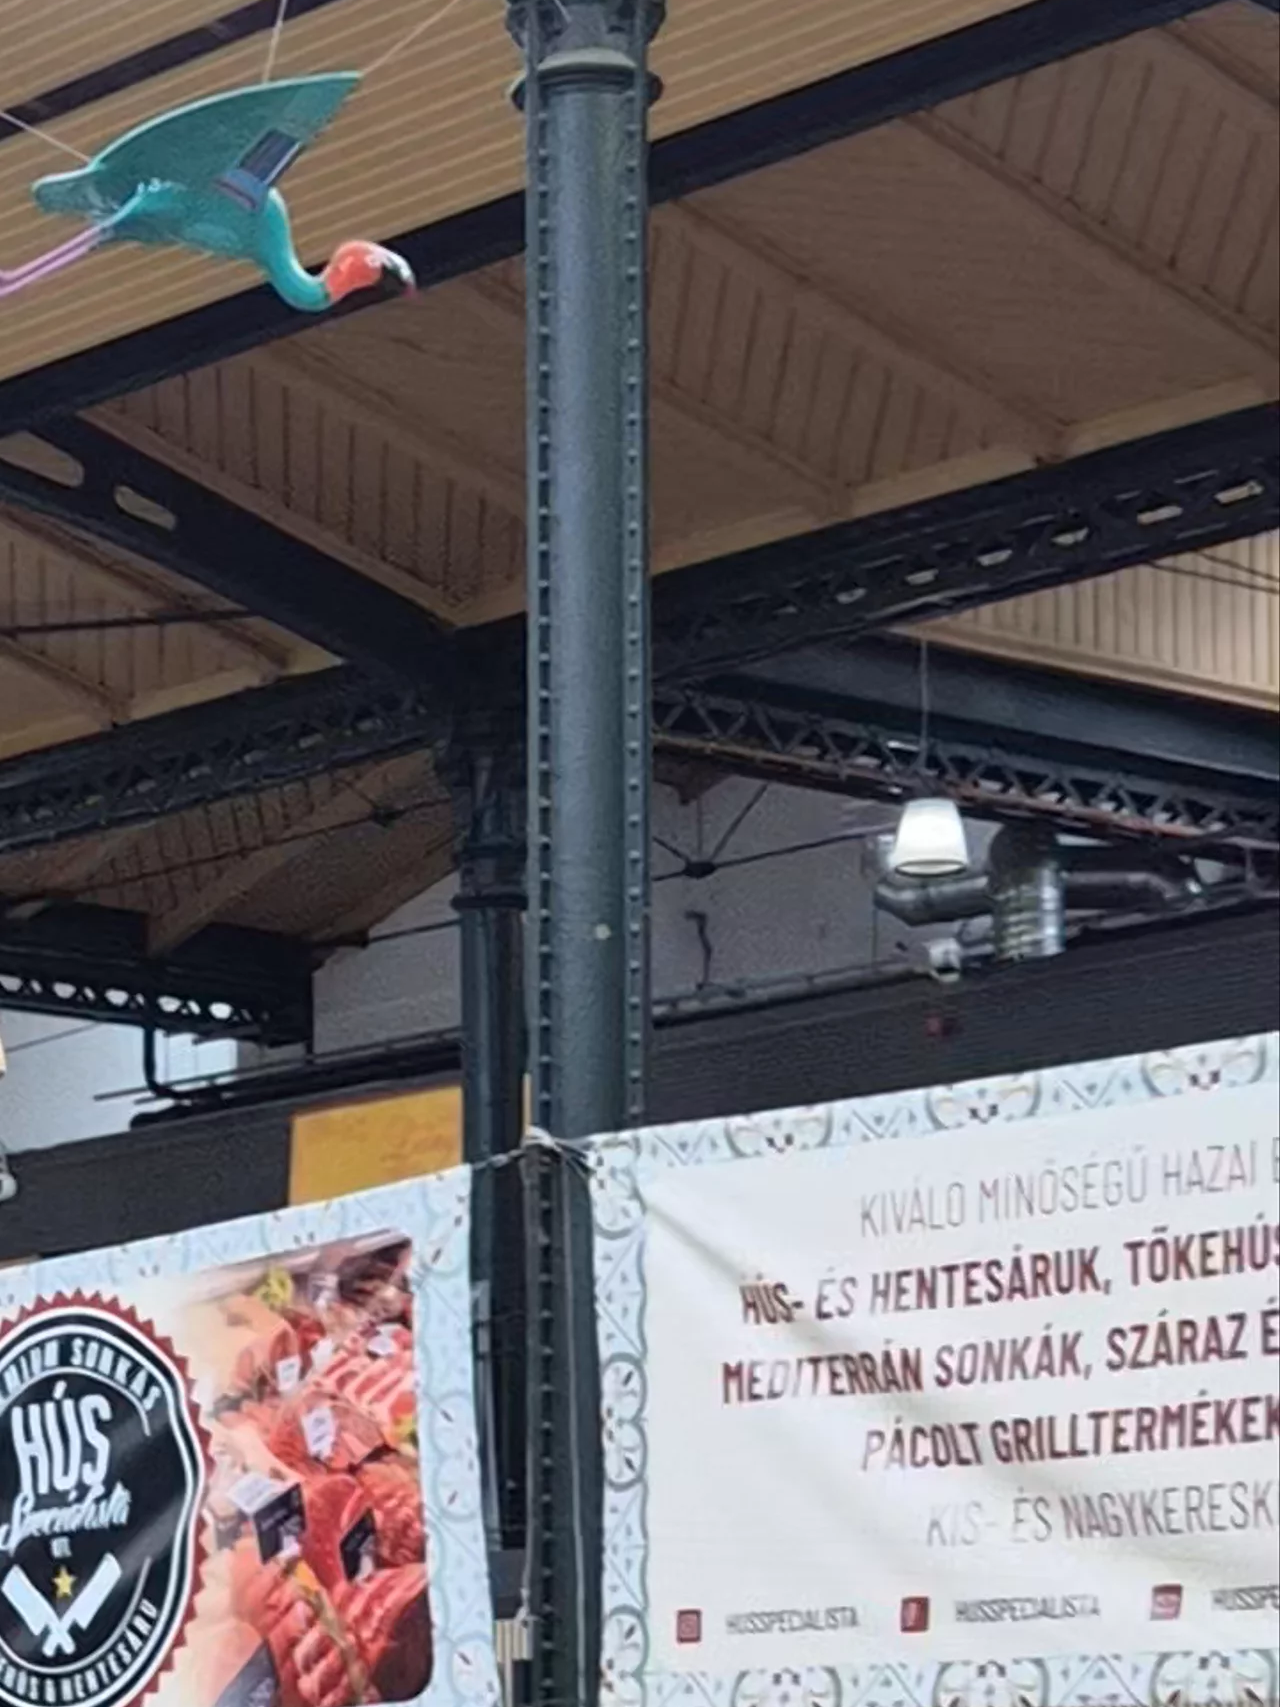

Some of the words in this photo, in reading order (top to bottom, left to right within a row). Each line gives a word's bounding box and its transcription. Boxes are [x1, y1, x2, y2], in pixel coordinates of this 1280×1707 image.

[1162, 1140, 1258, 1196] HAZAI
[815, 1266, 859, 1321] ÉS
[870, 1244, 1111, 1315] HENTESÁRUK,
[722, 1338, 925, 1404] MEDITERRÁN
[934, 1323, 1092, 1388] SONKÁK,
[1106, 1309, 1248, 1371] SZÁRAZ
[10, 1379, 114, 1495] HÚS
[861, 1416, 984, 1471] PÁCOLT
[1010, 1487, 1053, 1543] ÉS
